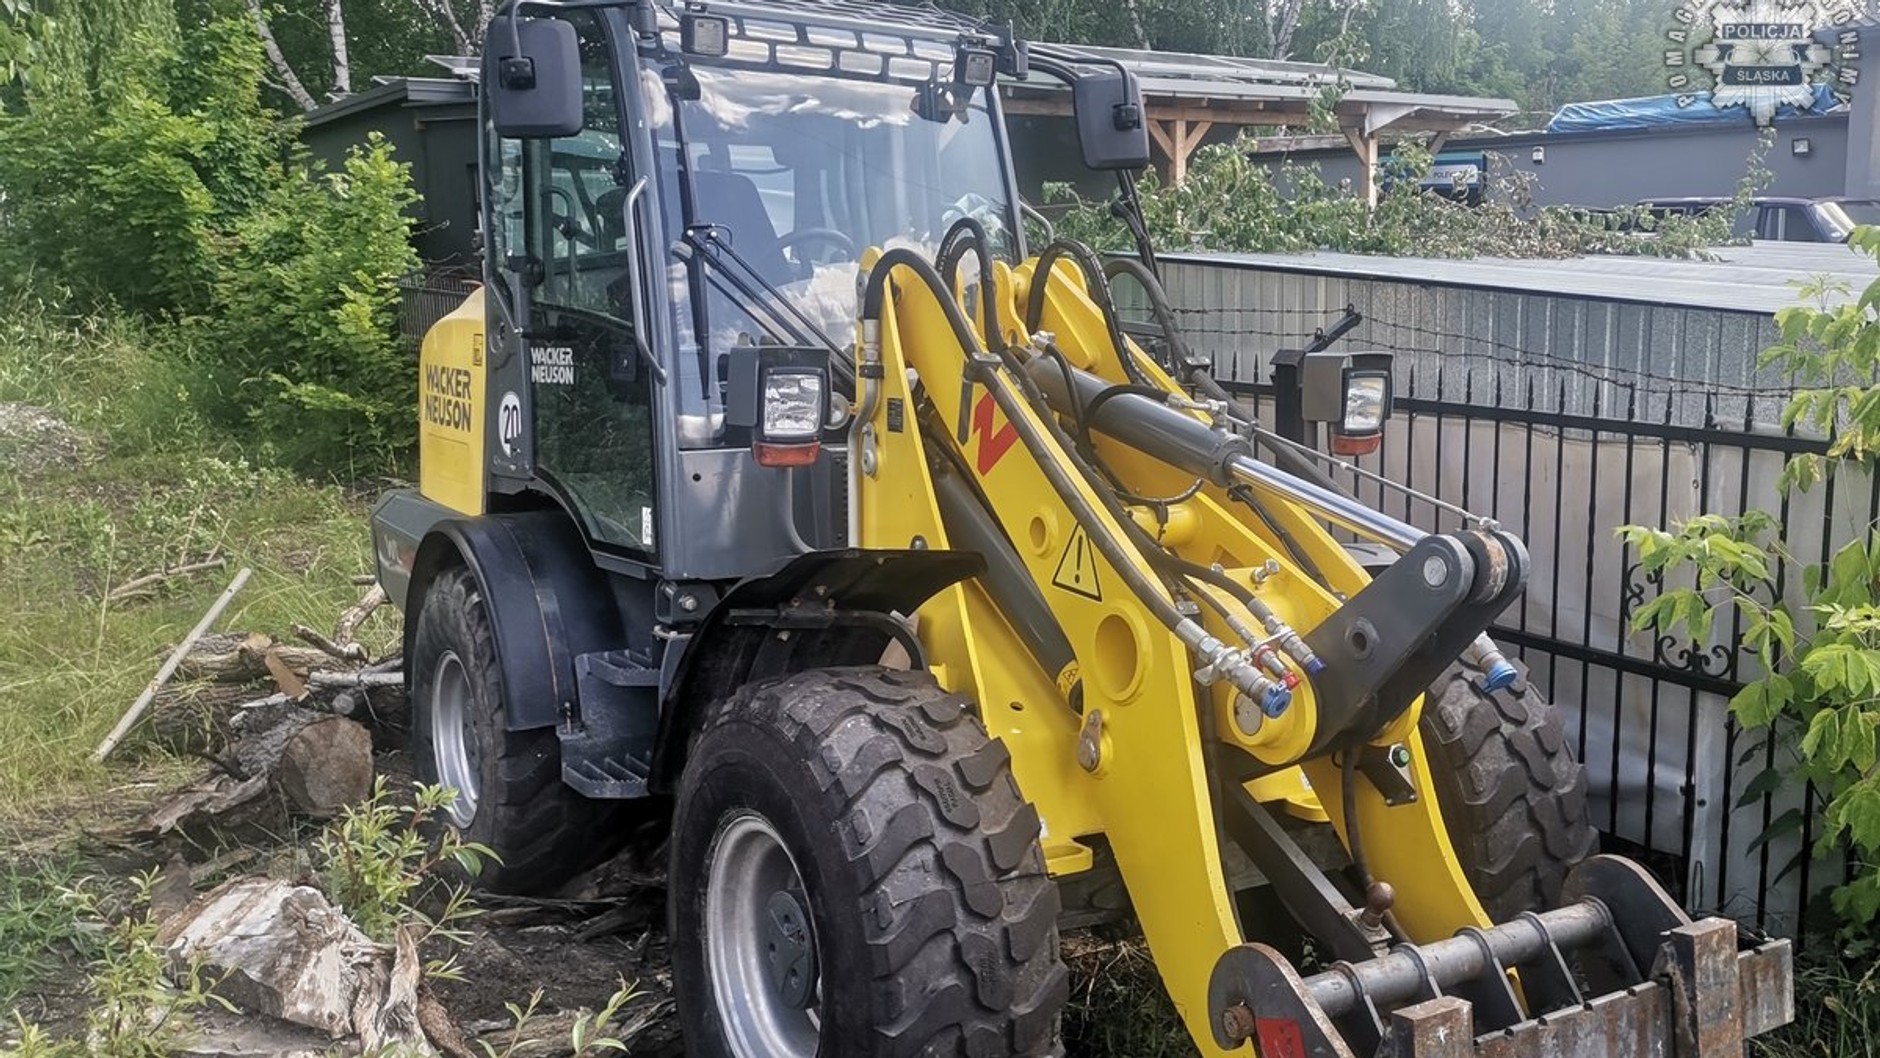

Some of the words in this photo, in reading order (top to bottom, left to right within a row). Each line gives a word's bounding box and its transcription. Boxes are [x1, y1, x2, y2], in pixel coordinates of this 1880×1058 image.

[531, 347, 574, 365] WACKER
[425, 364, 472, 400] WACKER
[531, 365, 574, 385] NEUSON
[425, 394, 472, 432] NEUSON
[503, 404, 520, 444] 20
